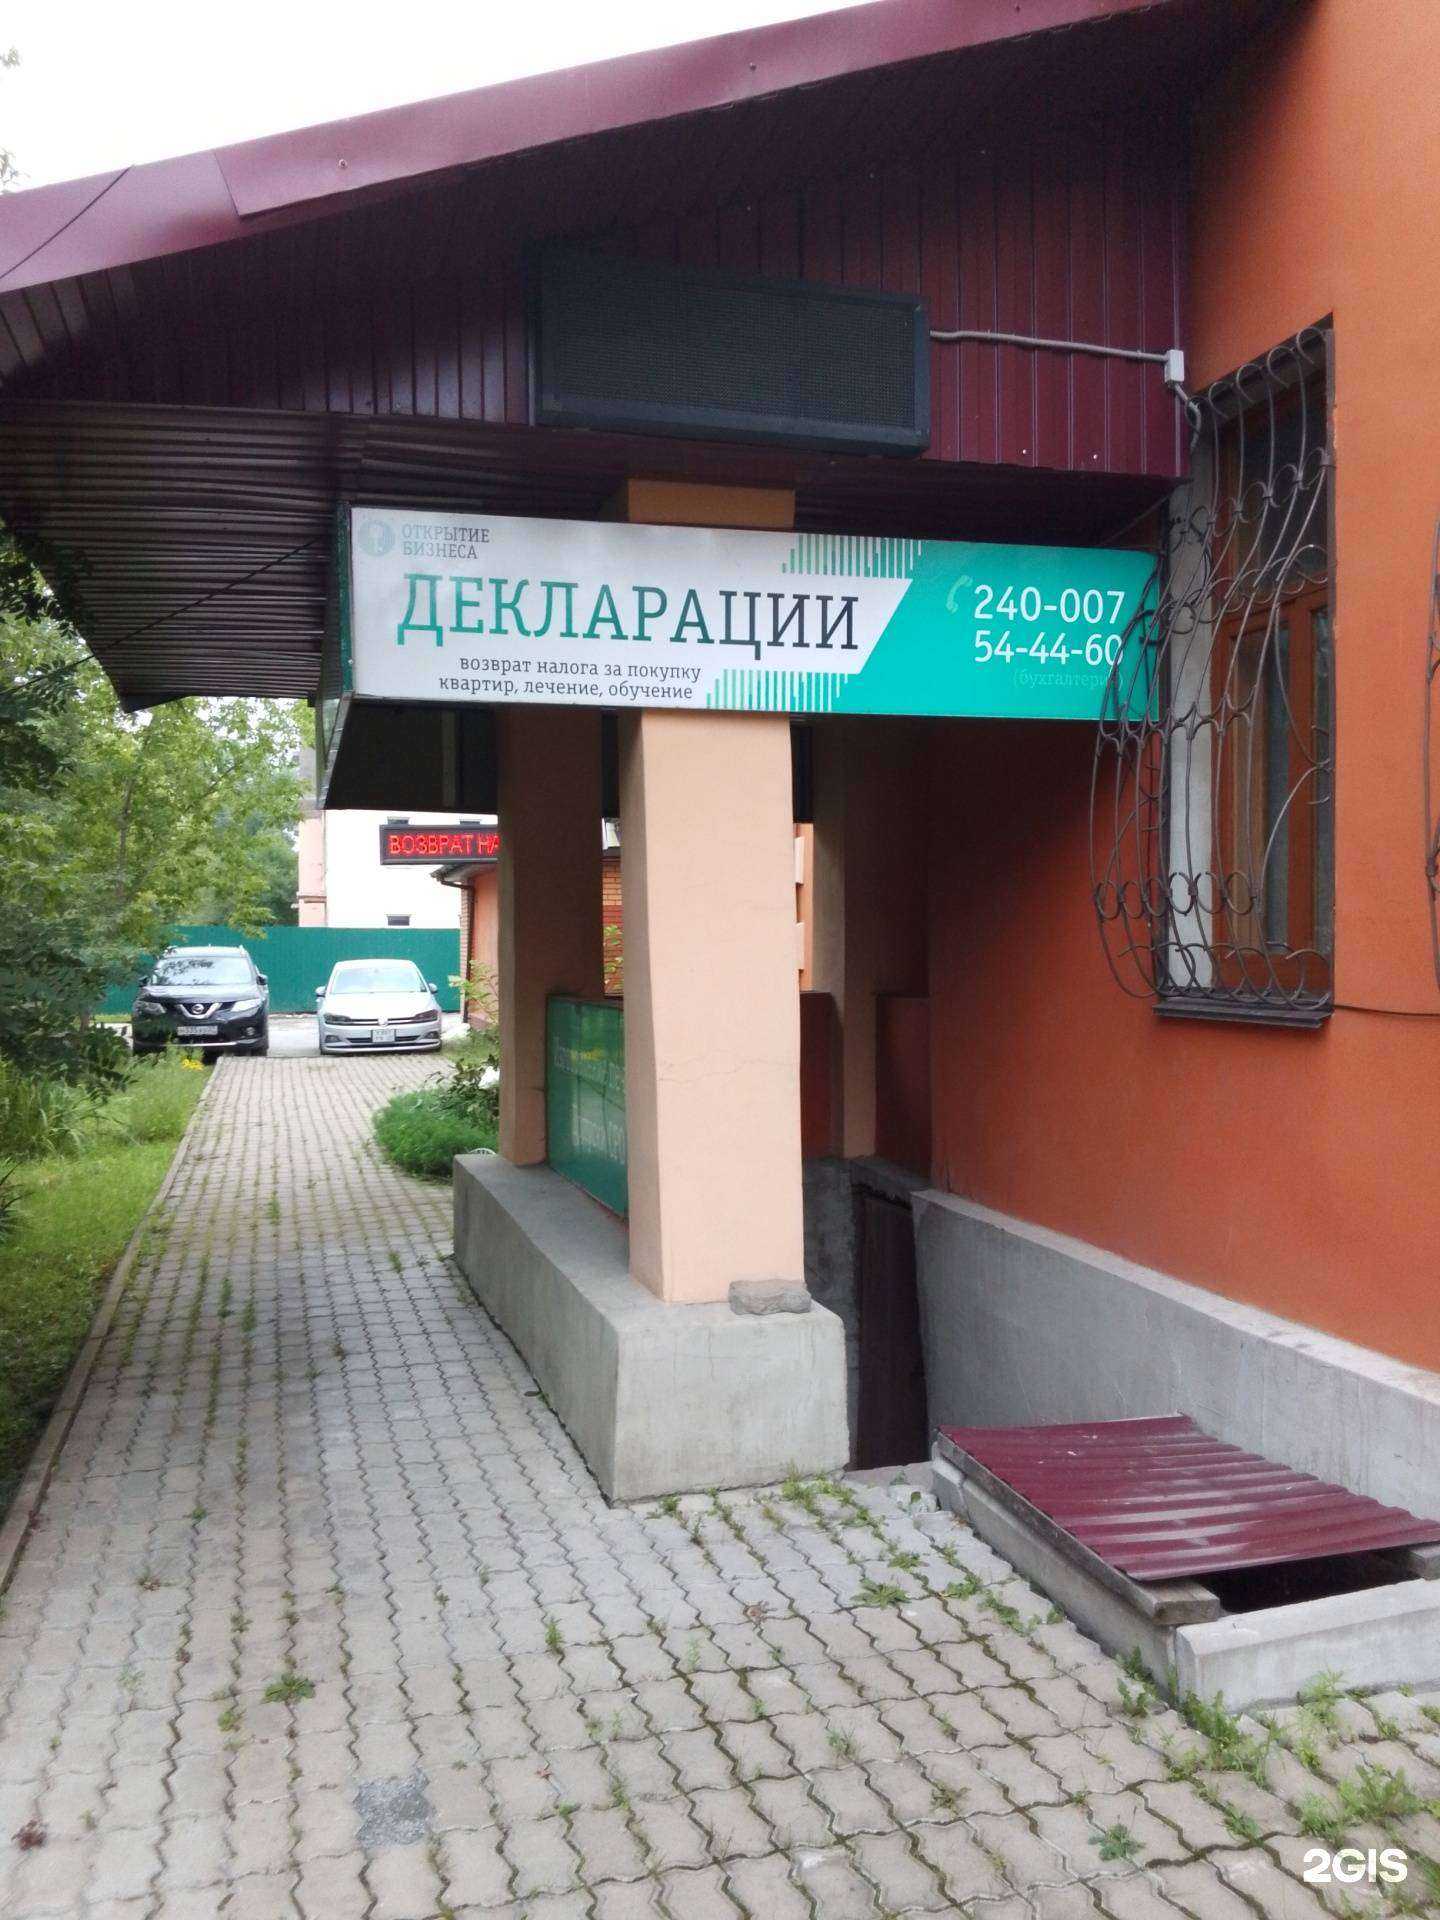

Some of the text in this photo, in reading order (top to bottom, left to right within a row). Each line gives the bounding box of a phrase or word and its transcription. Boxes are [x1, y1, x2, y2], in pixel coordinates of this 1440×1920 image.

[401, 524, 490, 543] ОТКРЫТИЕ
[402, 542, 478, 559] БИЗНЕСА
[397, 573, 859, 660] ДЕКЛАРАЦИИ
[974, 584, 1125, 624] 240-007
[975, 630, 1124, 666] 54-44-60
[460, 657, 701, 683] возврат налога за покупку
[439, 676, 692, 701] квартир, лечение, обучение
[389, 834, 473, 855] ВОЗВРАТ
